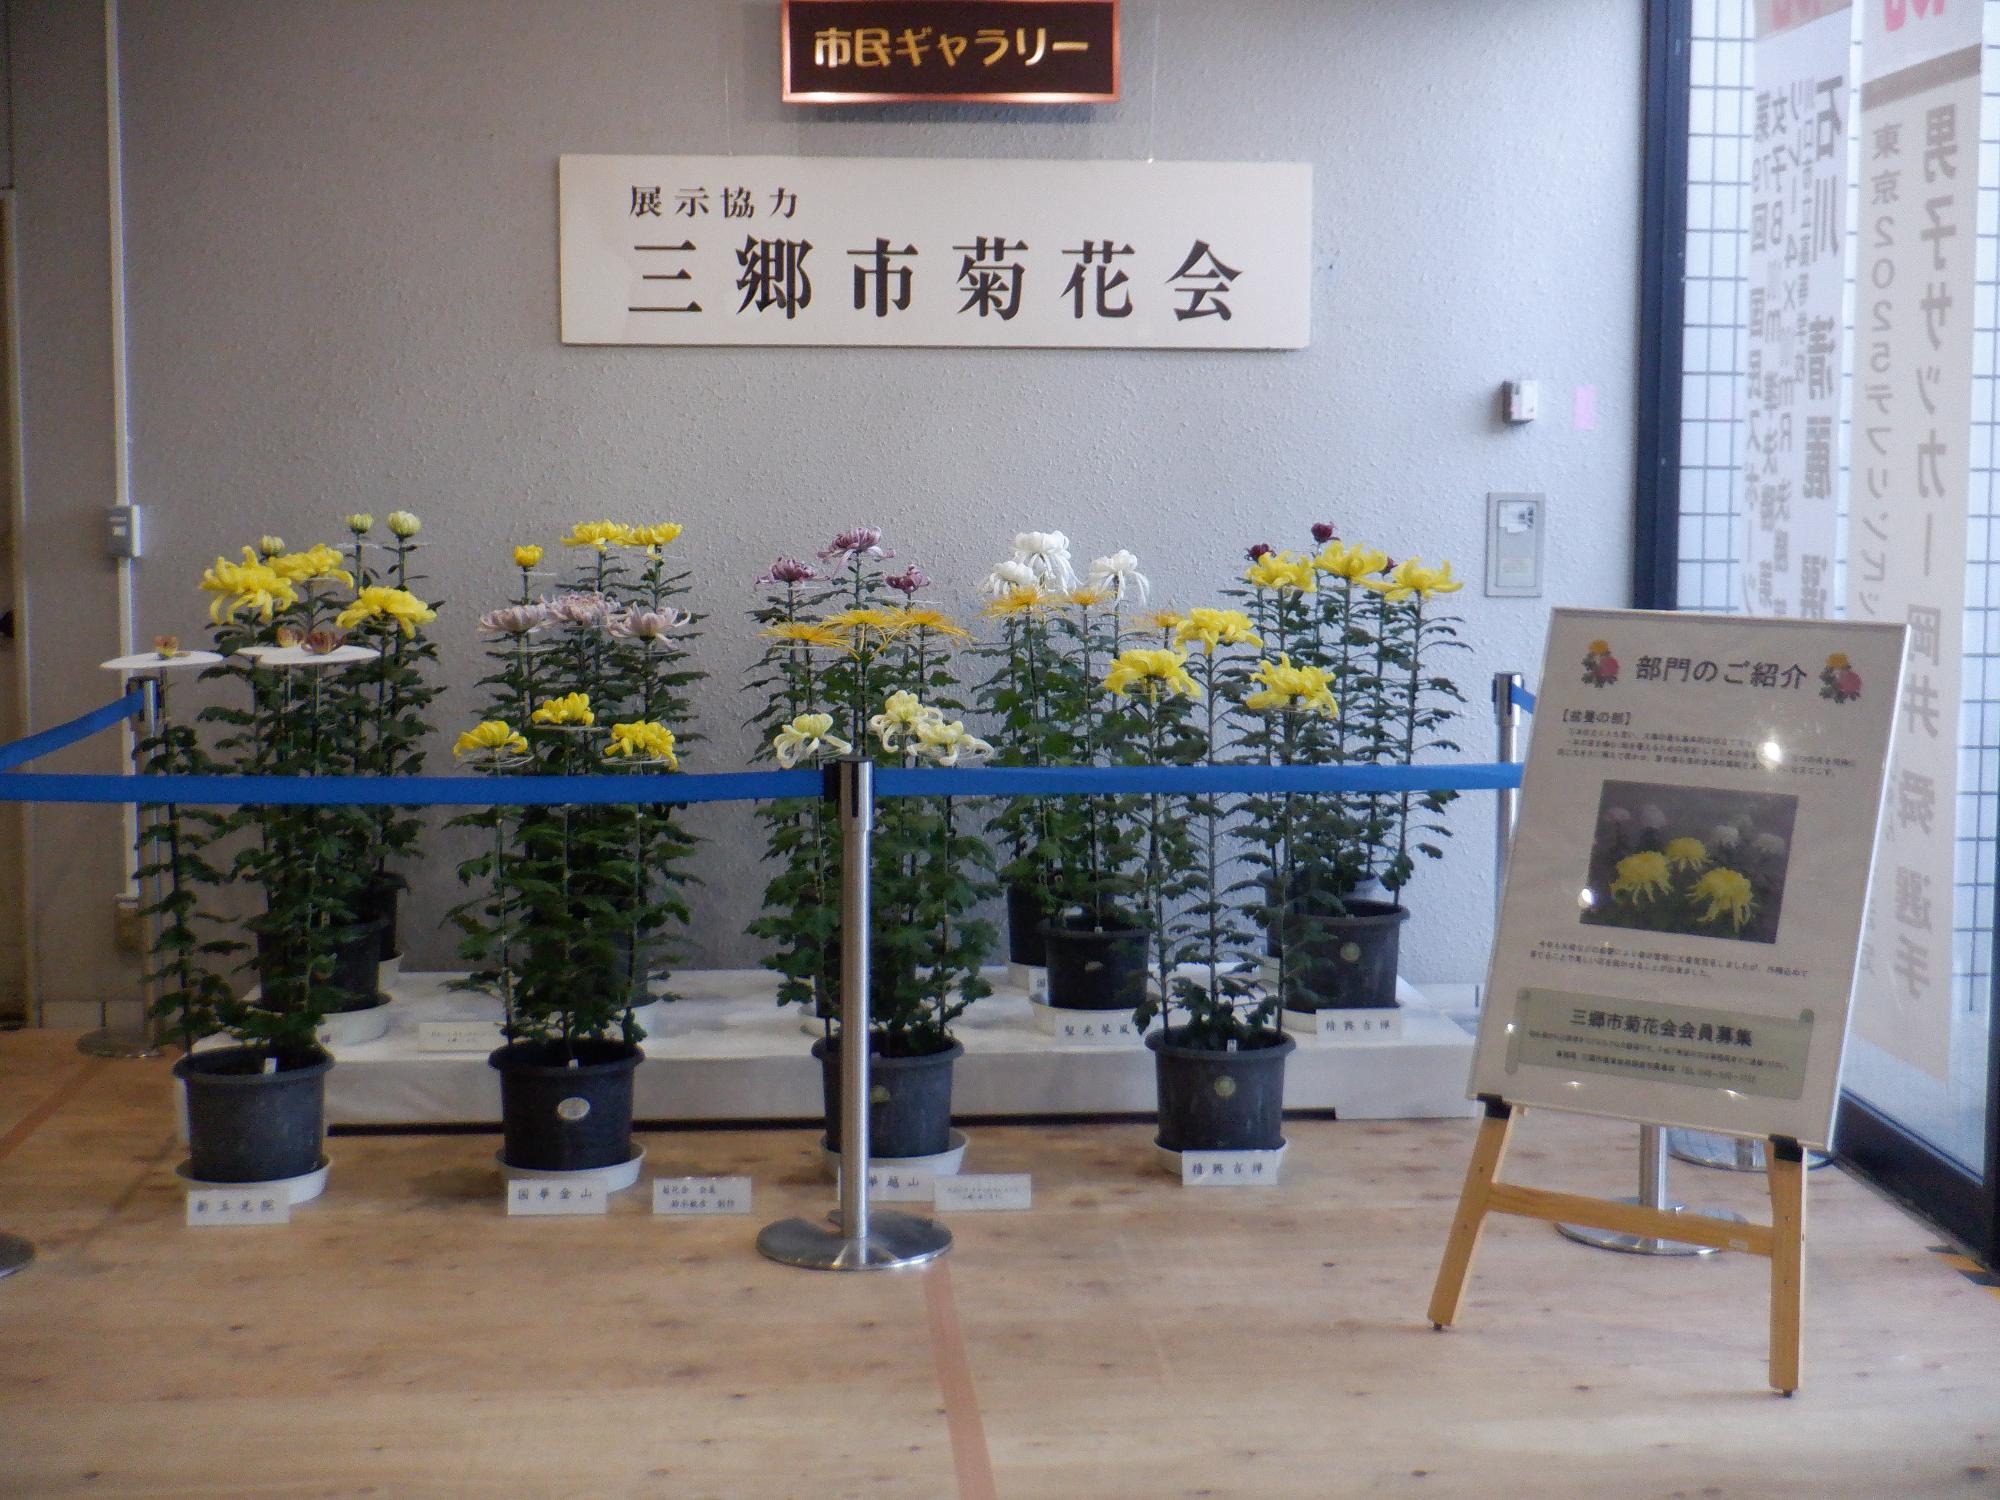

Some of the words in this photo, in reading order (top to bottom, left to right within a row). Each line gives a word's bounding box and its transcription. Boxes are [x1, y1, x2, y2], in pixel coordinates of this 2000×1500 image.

[814, 26, 1090, 68] 市民ギャラリー
[629, 185, 799, 218] 展示協力
[628, 234, 1244, 322] 三郷市菊花会
[1635, 654, 1808, 691] 部門のご紹介
[1569, 1008, 1753, 1047] 三郷市菊花会会員募集
